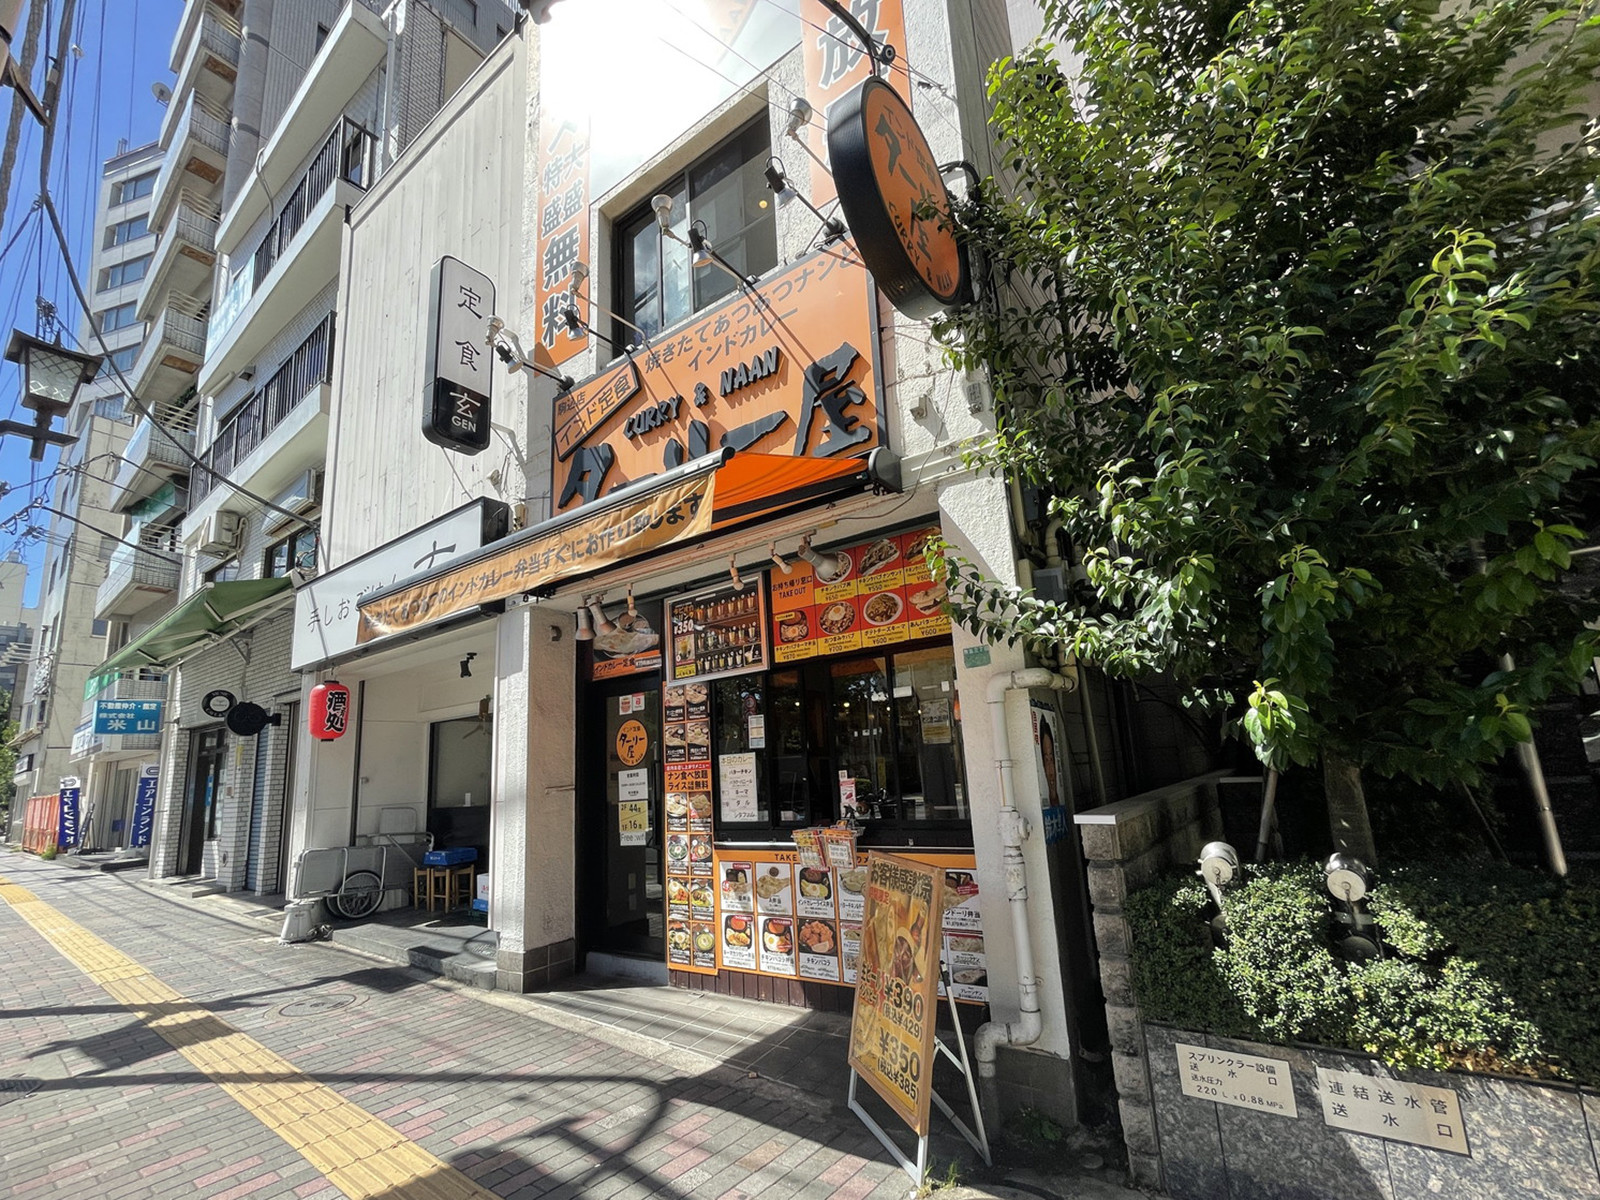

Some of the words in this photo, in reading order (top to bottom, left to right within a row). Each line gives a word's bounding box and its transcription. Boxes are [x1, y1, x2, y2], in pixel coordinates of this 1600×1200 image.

[888, 203, 920, 266] CURRY
[541, 226, 579, 347] 無料
[455, 285, 483, 372] 定食
[687, 307, 799, 372] インドカレー
[449, 391, 481, 419] 玄
[559, 373, 632, 444] インド定食
[624, 396, 683, 441] CURRY
[693, 382, 709, 408] &
[719, 346, 781, 397] NAAN
[451, 415, 477, 433] GEN
[779, 589, 793, 599] TAKE
[794, 586, 806, 595] OUT
[106, 719, 156, 731] 米山
[325, 690, 348, 733] 酒処
[619, 732, 646, 748] ターリー
[626, 744, 635, 759] 屋
[668, 770, 709, 781] ナン食べ放題
[668, 781, 687, 790] ライス
[137, 780, 157, 844] エアコンランド
[775, 853, 797, 861] TAKE
[884, 974, 924, 1023] ¥390
[878, 1026, 921, 1083] ¥350
[1188, 1051, 1276, 1075] スプリンクラー設備
[1191, 1073, 1223, 1086] 送水圧力
[1196, 1084, 1217, 1096] 220
[1265, 1099, 1284, 1110] MPa
[1328, 1080, 1448, 1116] 連結送水管
[1332, 1102, 1453, 1138] 送水口
